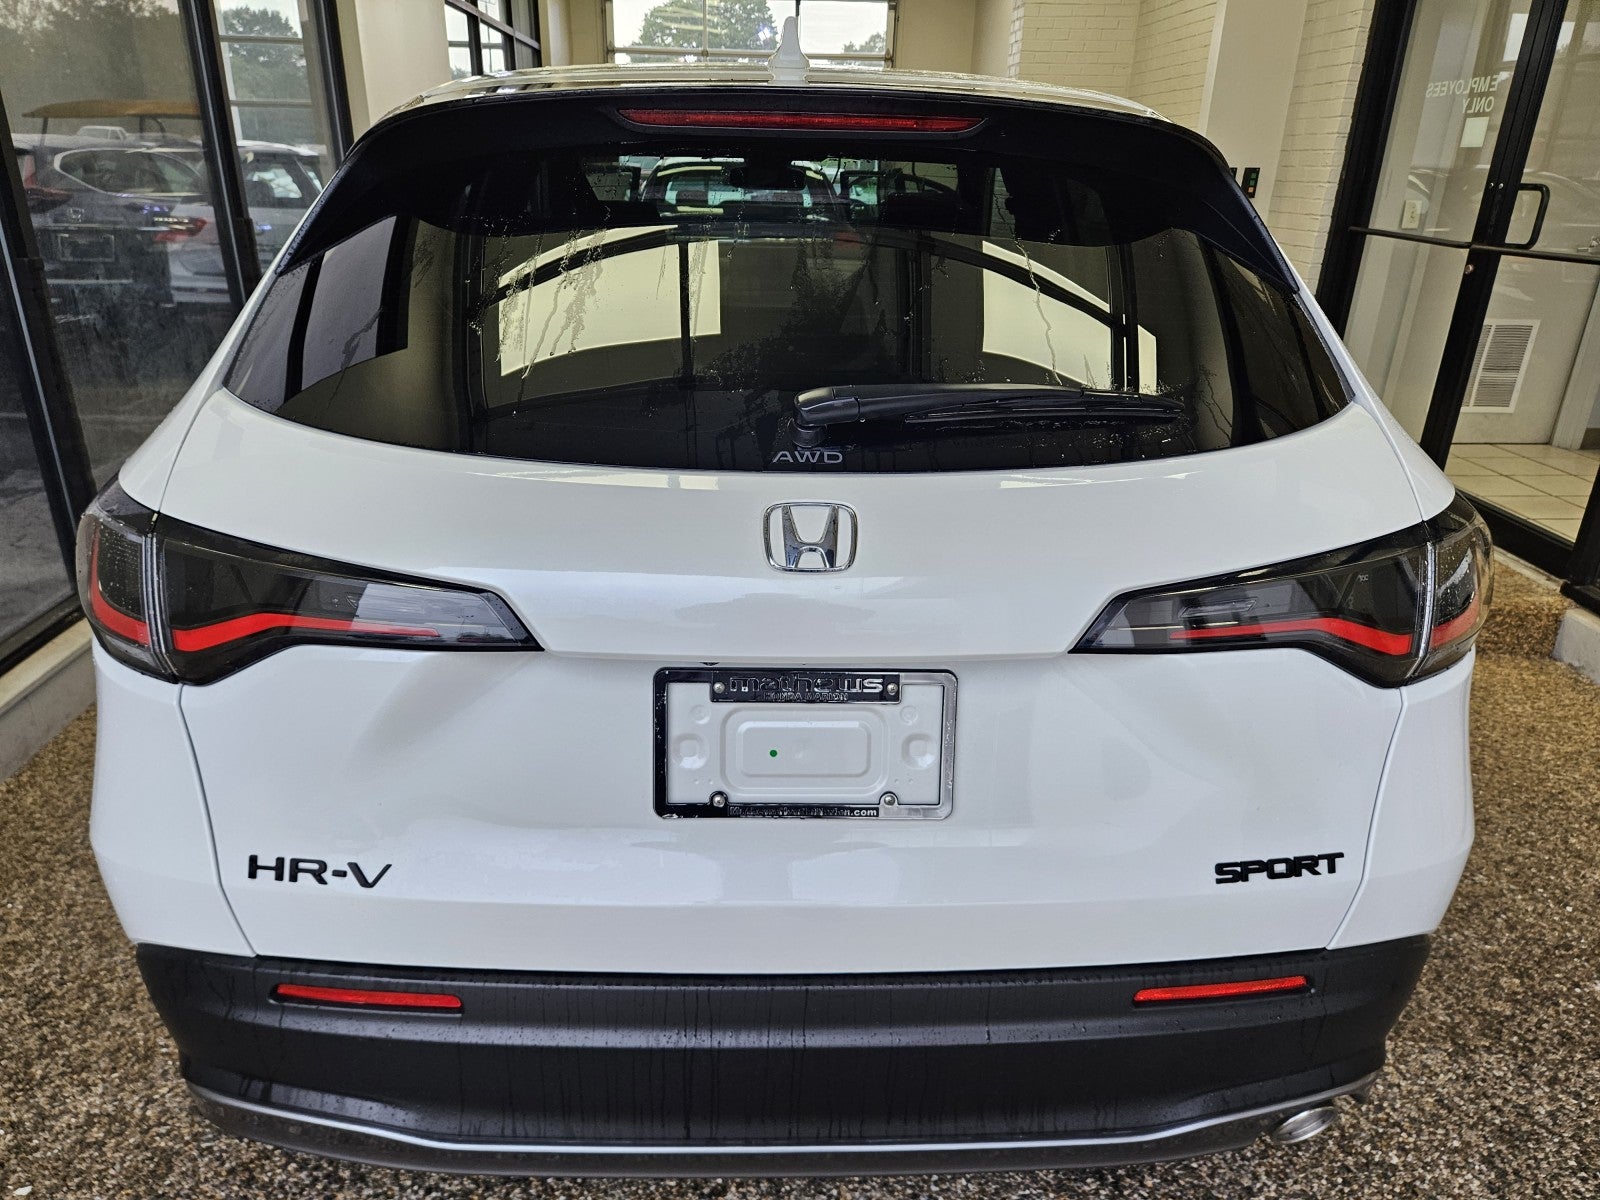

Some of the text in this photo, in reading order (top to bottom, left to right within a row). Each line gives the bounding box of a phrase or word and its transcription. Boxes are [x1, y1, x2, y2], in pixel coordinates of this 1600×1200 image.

[772, 450, 843, 464] AWD
[247, 854, 393, 889] HR-V
[1214, 851, 1345, 885] SPORT
